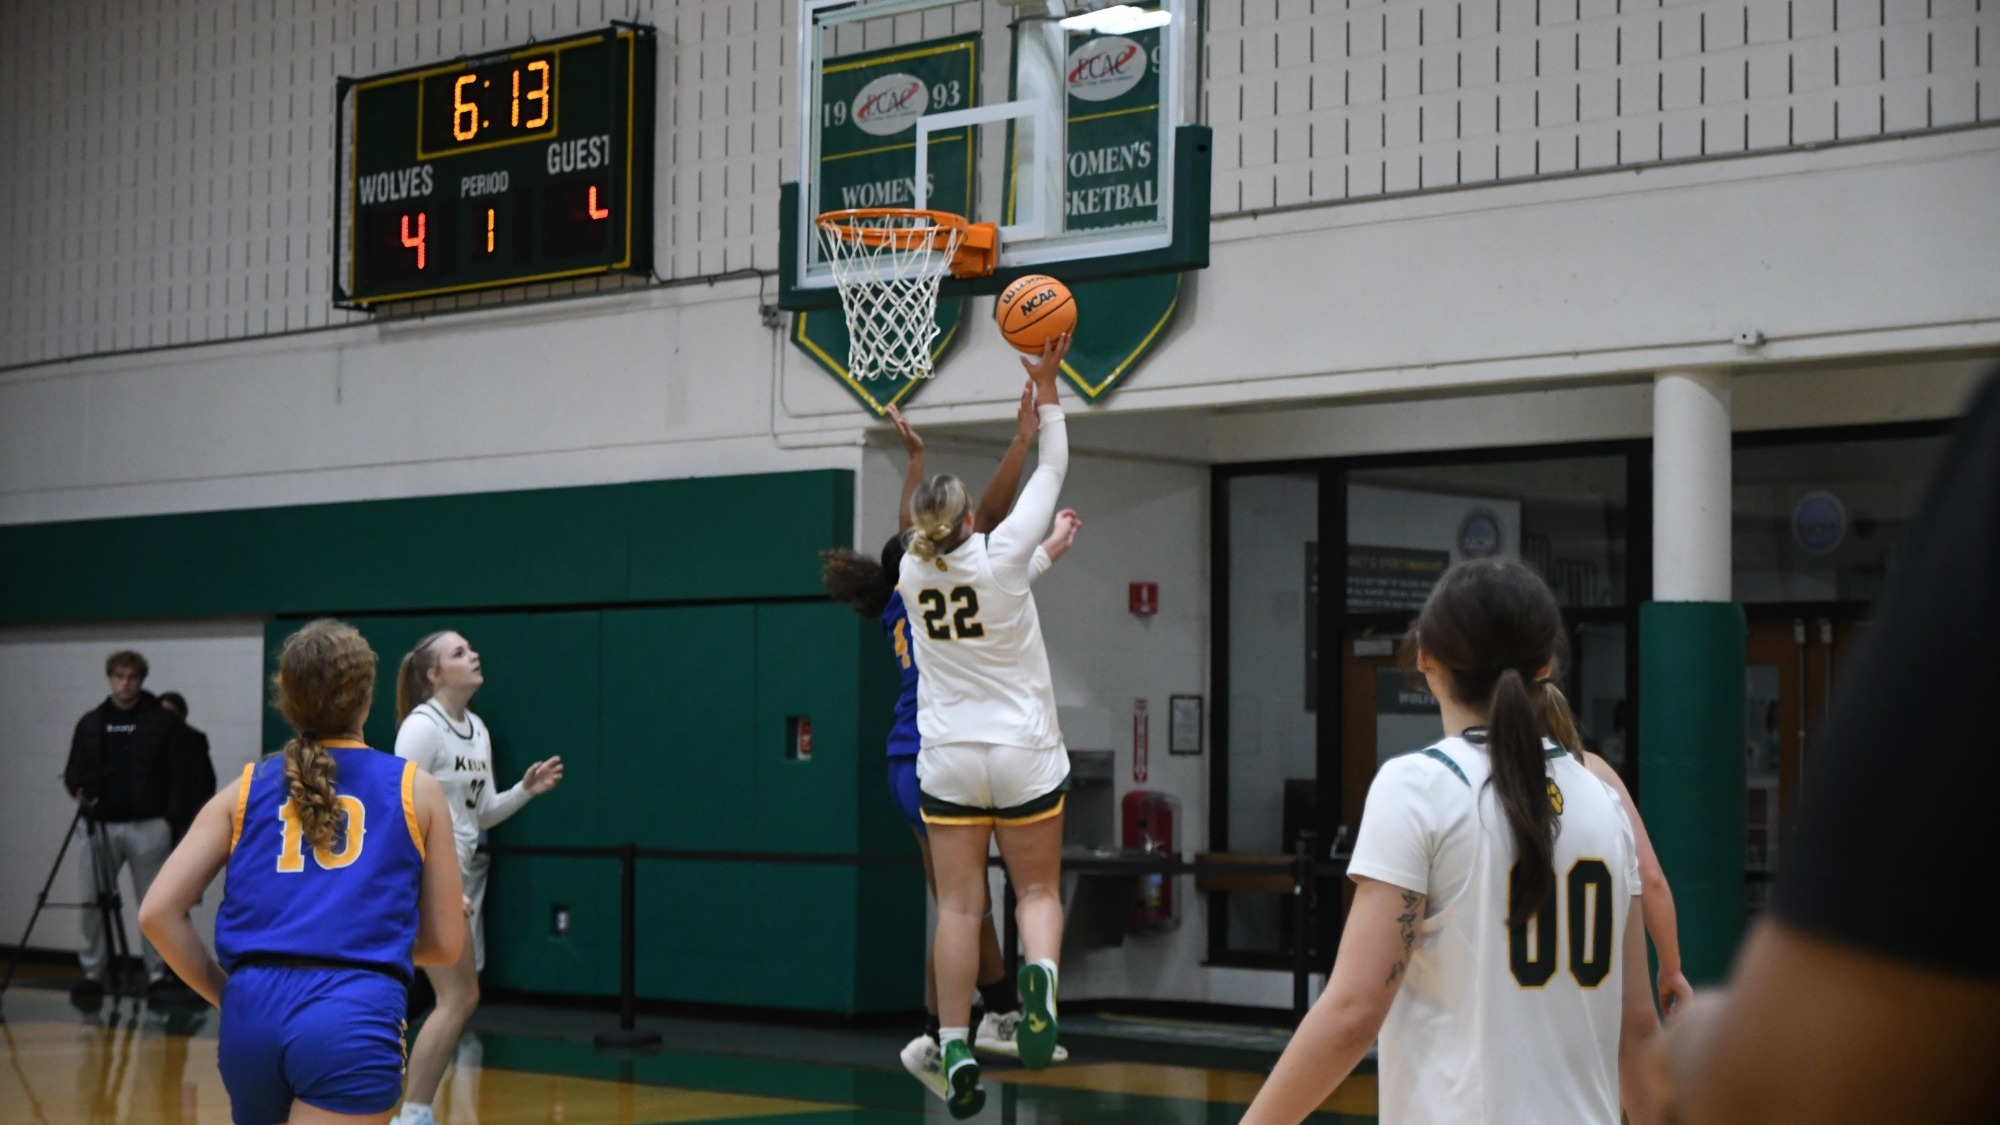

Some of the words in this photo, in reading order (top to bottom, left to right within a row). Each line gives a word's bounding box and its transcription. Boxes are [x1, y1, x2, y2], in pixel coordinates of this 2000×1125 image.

[453, 60, 550, 141] 6:13
[823, 101, 847, 127] 19
[932, 79, 961, 109] 93
[546, 134, 610, 175] GUEST
[1066, 140, 1152, 178] OMEN'S
[359, 164, 434, 205] WOLVES
[460, 170, 509, 199] PERIOD
[401, 212, 426, 269] 4
[487, 208, 495, 252] 1
[1020, 288, 1057, 317] NCAA
[918, 585, 985, 640] 22
[276, 794, 367, 873] 10
